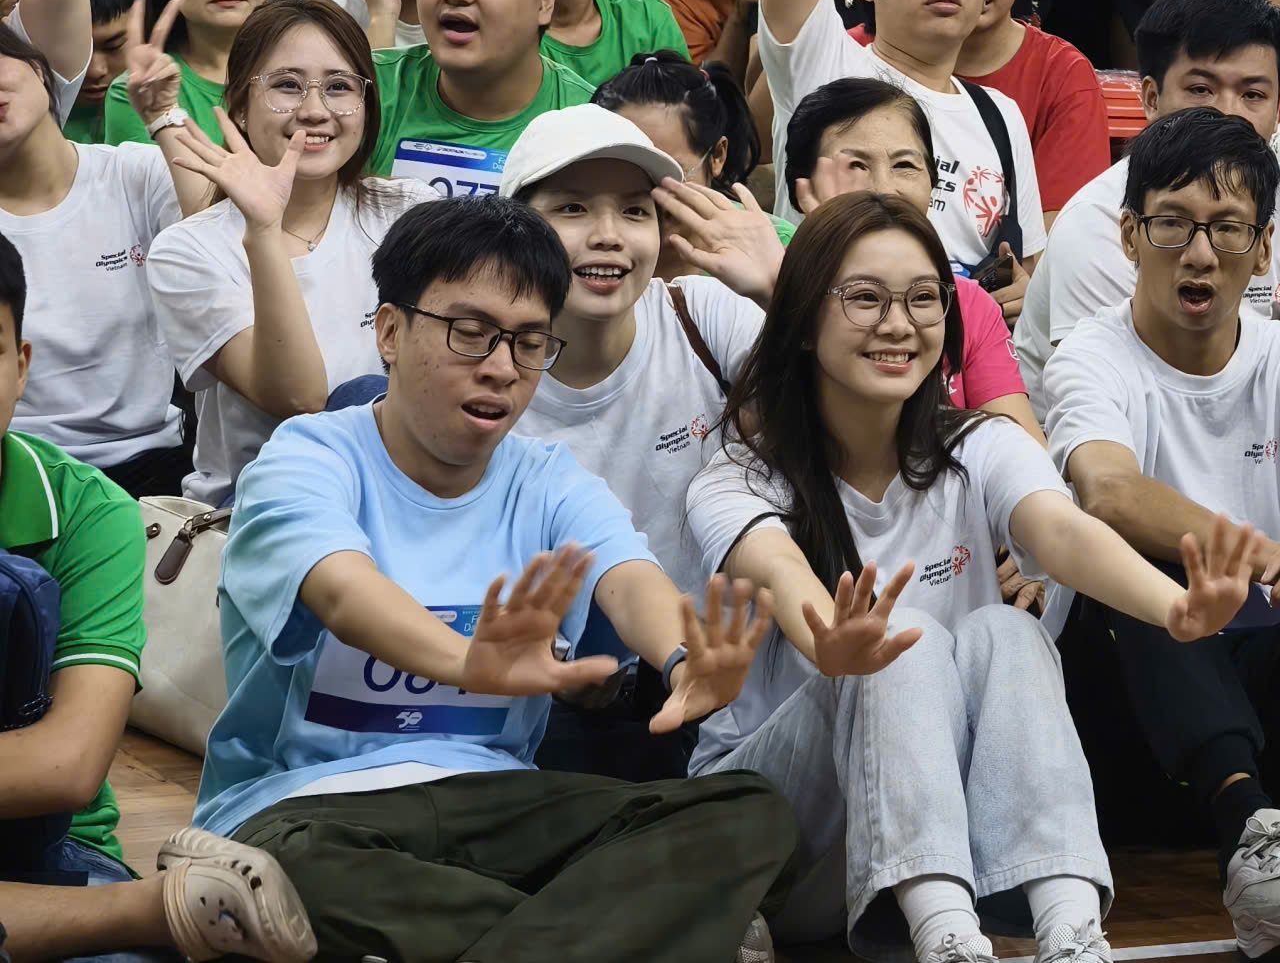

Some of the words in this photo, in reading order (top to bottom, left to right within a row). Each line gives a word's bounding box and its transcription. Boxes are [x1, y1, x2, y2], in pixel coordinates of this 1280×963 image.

[95, 256, 128, 267] Olympics
[101, 249, 126, 260] Special
[660, 425, 688, 441] Special
[655, 432, 690, 451] Olympics
[667, 441, 691, 454] Vietnam
[925, 556, 952, 572] Special
[919, 565, 952, 582] Olympic
[930, 574, 952, 586] Vietna
